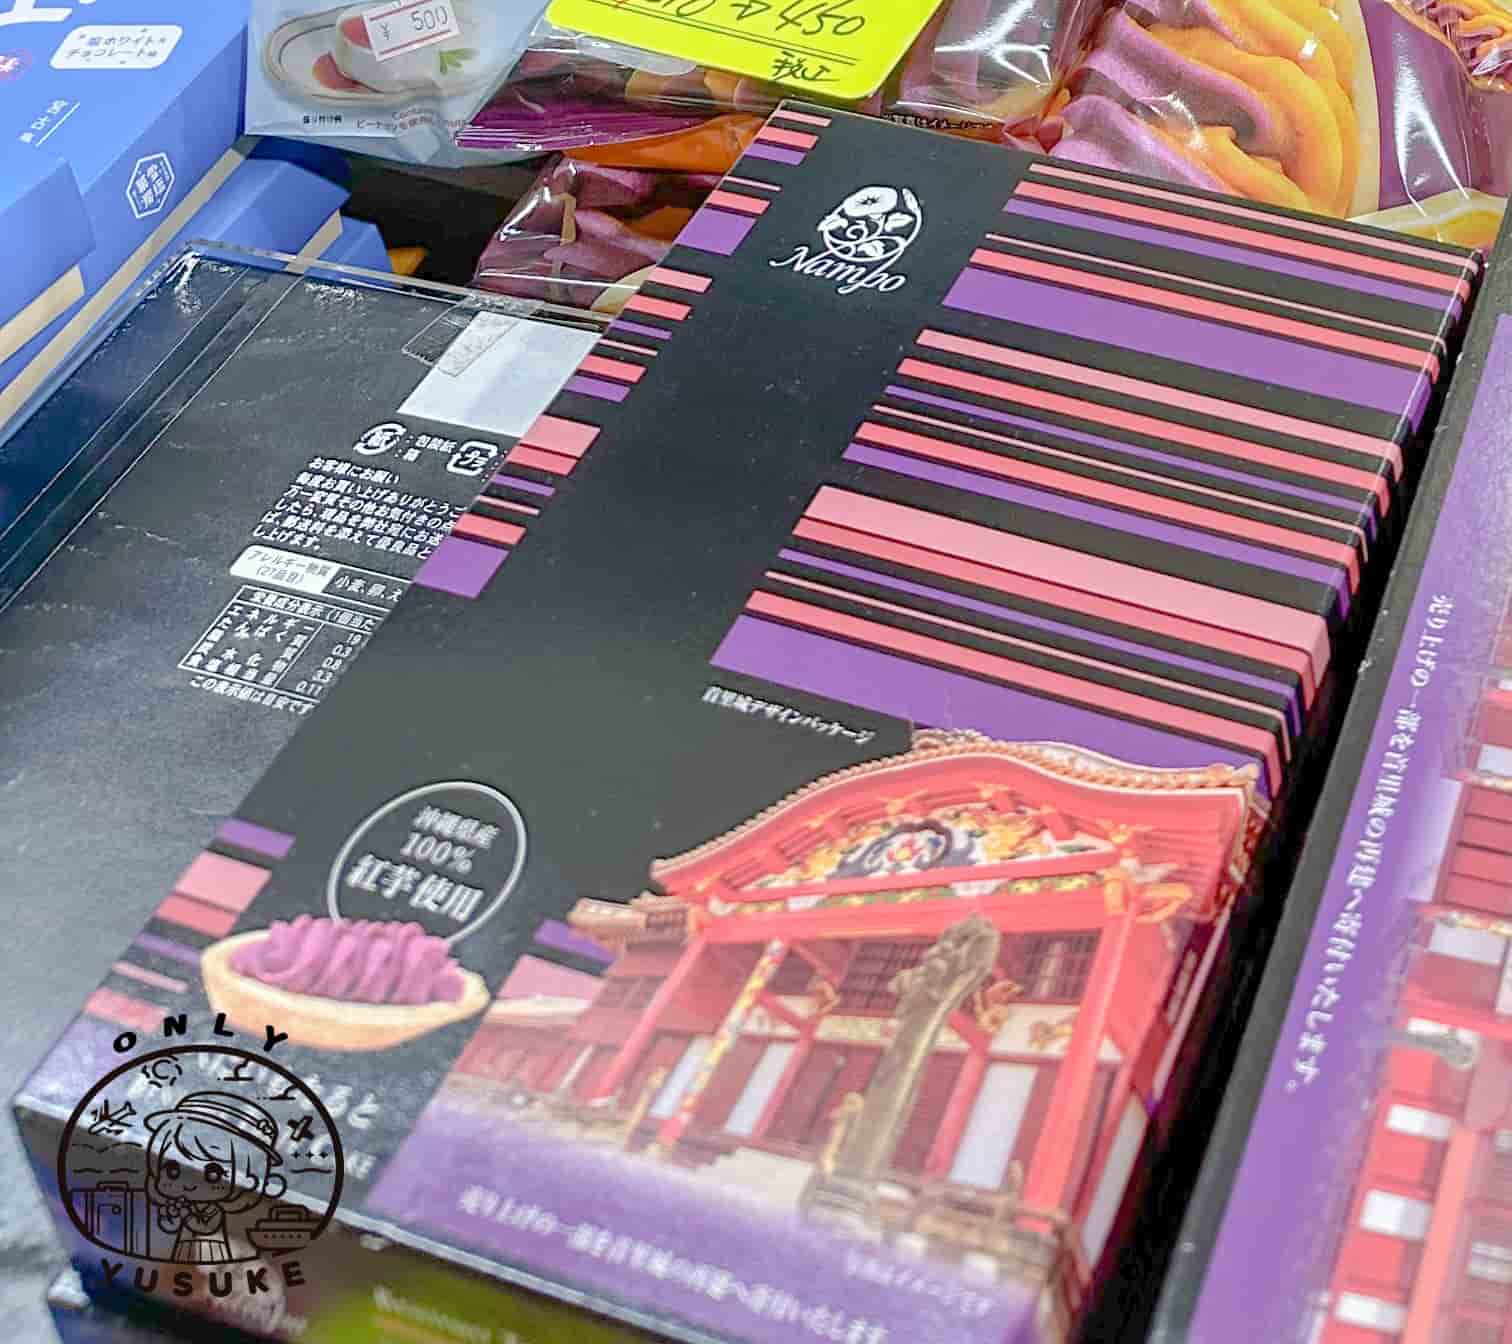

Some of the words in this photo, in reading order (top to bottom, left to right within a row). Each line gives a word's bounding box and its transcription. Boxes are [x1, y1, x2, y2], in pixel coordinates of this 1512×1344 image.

[410, 3, 450, 34] 500
[769, 245, 909, 297] Nampo
[402, 831, 476, 875] 100%
[348, 855, 488, 921] 紅芋使用
